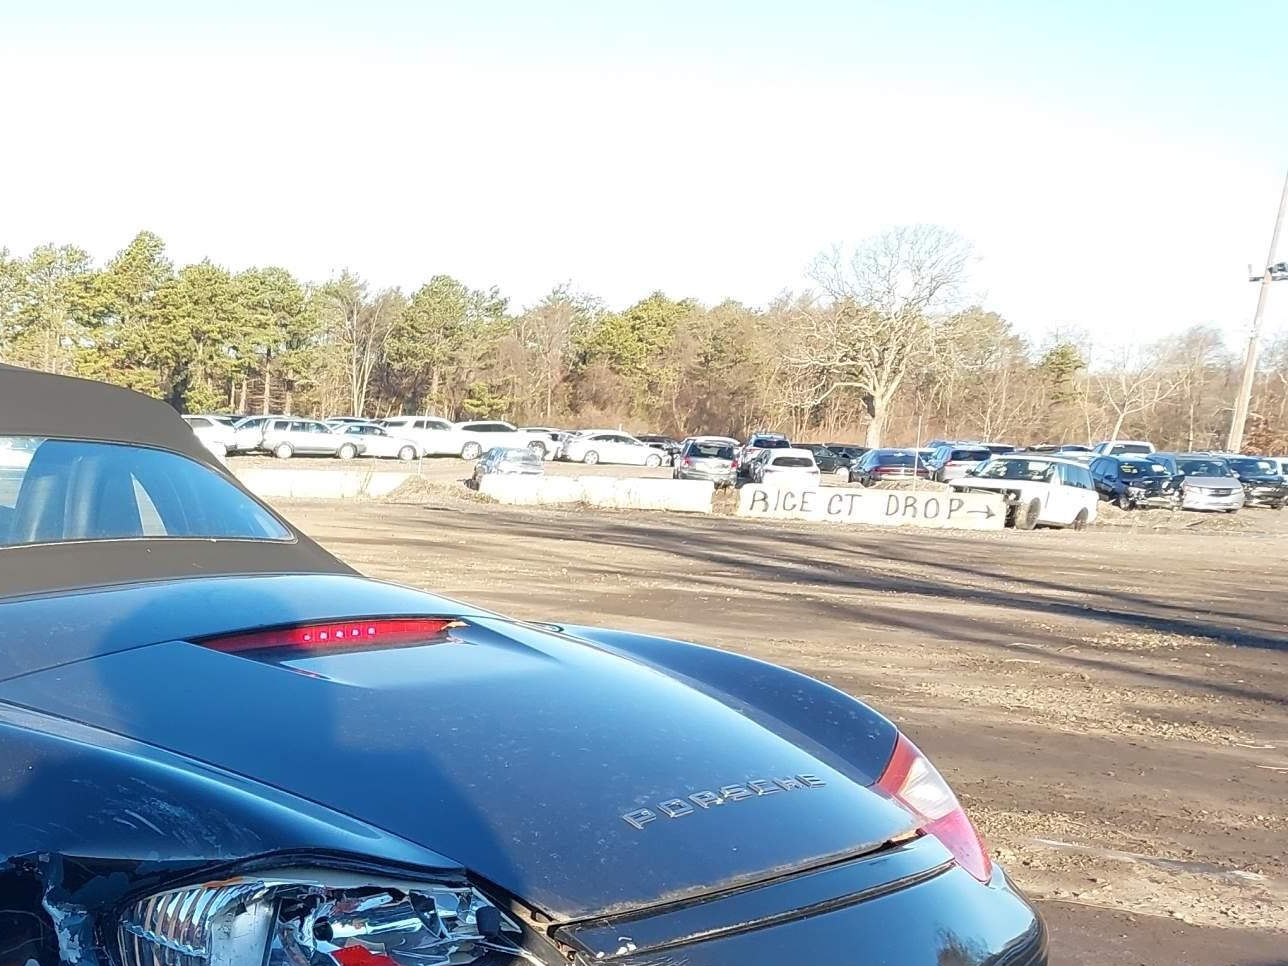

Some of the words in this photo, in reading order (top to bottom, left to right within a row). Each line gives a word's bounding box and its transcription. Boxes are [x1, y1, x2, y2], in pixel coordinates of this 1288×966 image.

[827, 493, 862, 516] CT
[885, 494, 964, 519] DROP
[622, 774, 826, 830] PORSCHE
